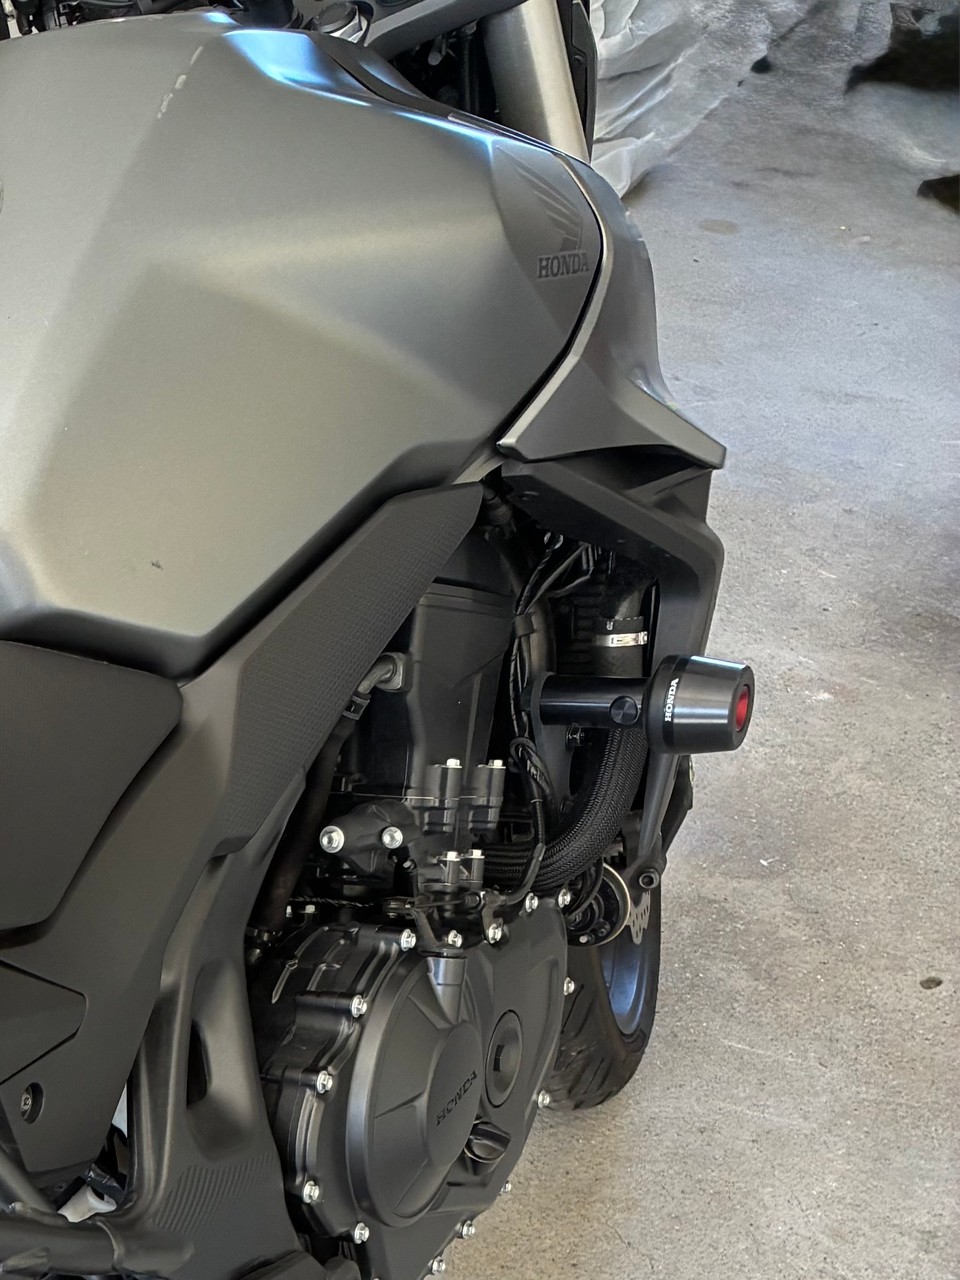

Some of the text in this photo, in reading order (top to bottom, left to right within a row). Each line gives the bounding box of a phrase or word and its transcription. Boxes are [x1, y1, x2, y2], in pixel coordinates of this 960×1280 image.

[537, 252, 590, 279] HONDA
[664, 678, 680, 722] HONDA
[436, 1070, 478, 1127] HONDA
